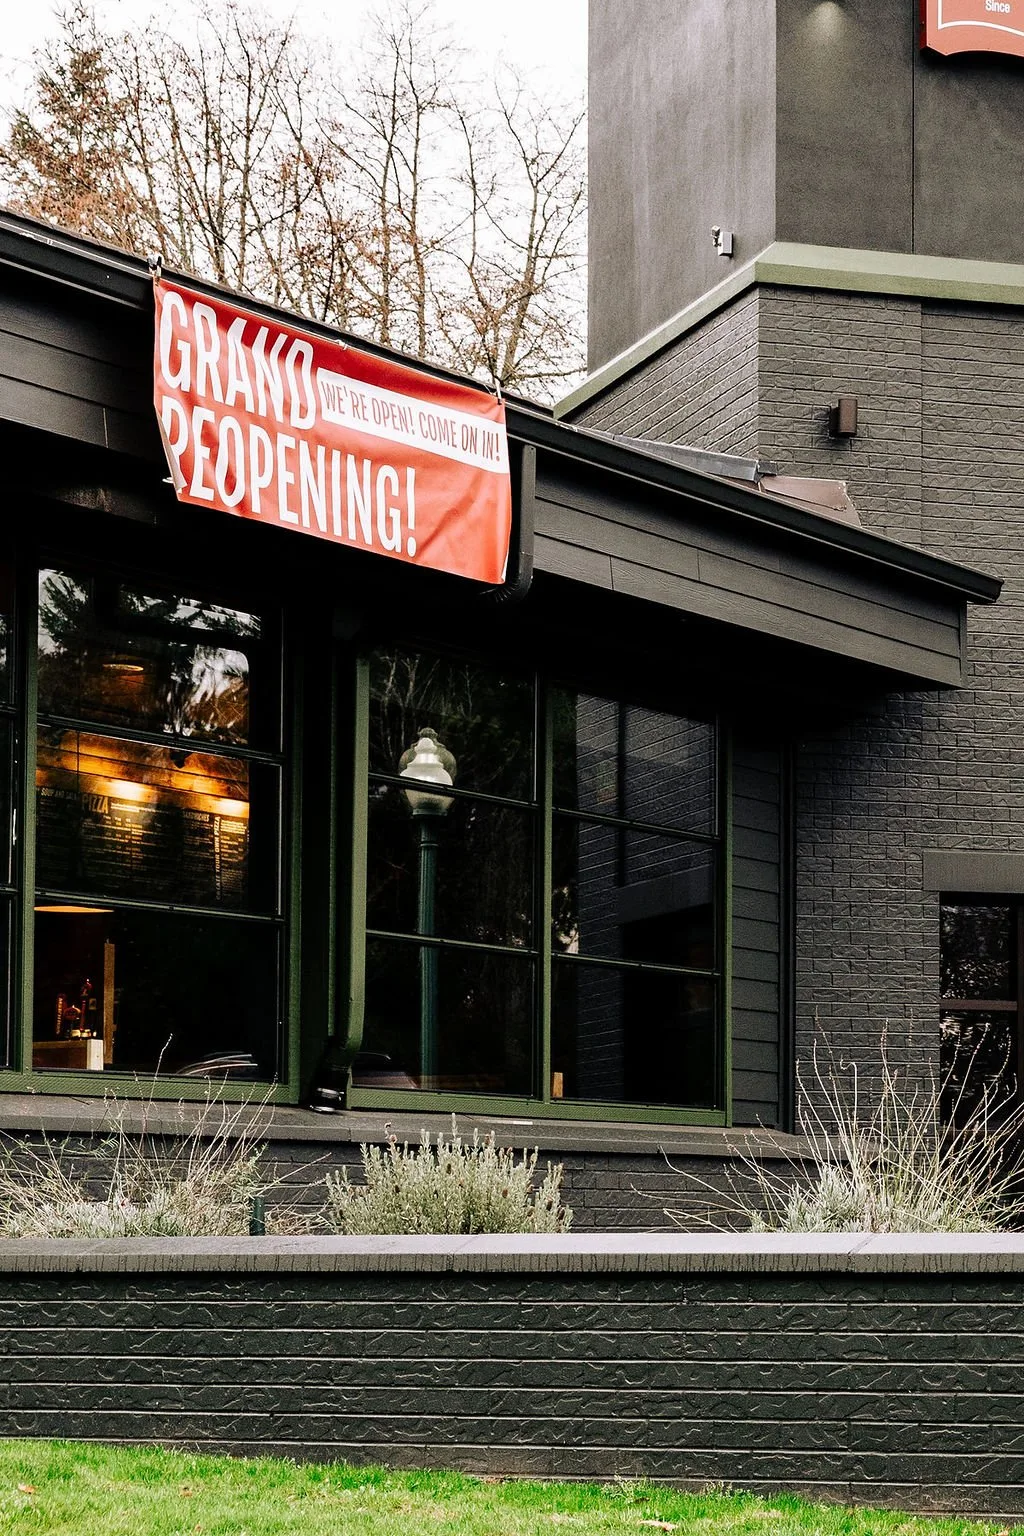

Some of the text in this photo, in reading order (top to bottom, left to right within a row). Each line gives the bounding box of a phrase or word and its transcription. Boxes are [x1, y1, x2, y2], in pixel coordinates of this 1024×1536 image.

[159, 291, 317, 431] GRAND
[161, 395, 417, 558] REOPENING!
[320, 380, 501, 462] WE'RE OPEN! COME ON IN!
[82, 793, 109, 814] PIZZA
